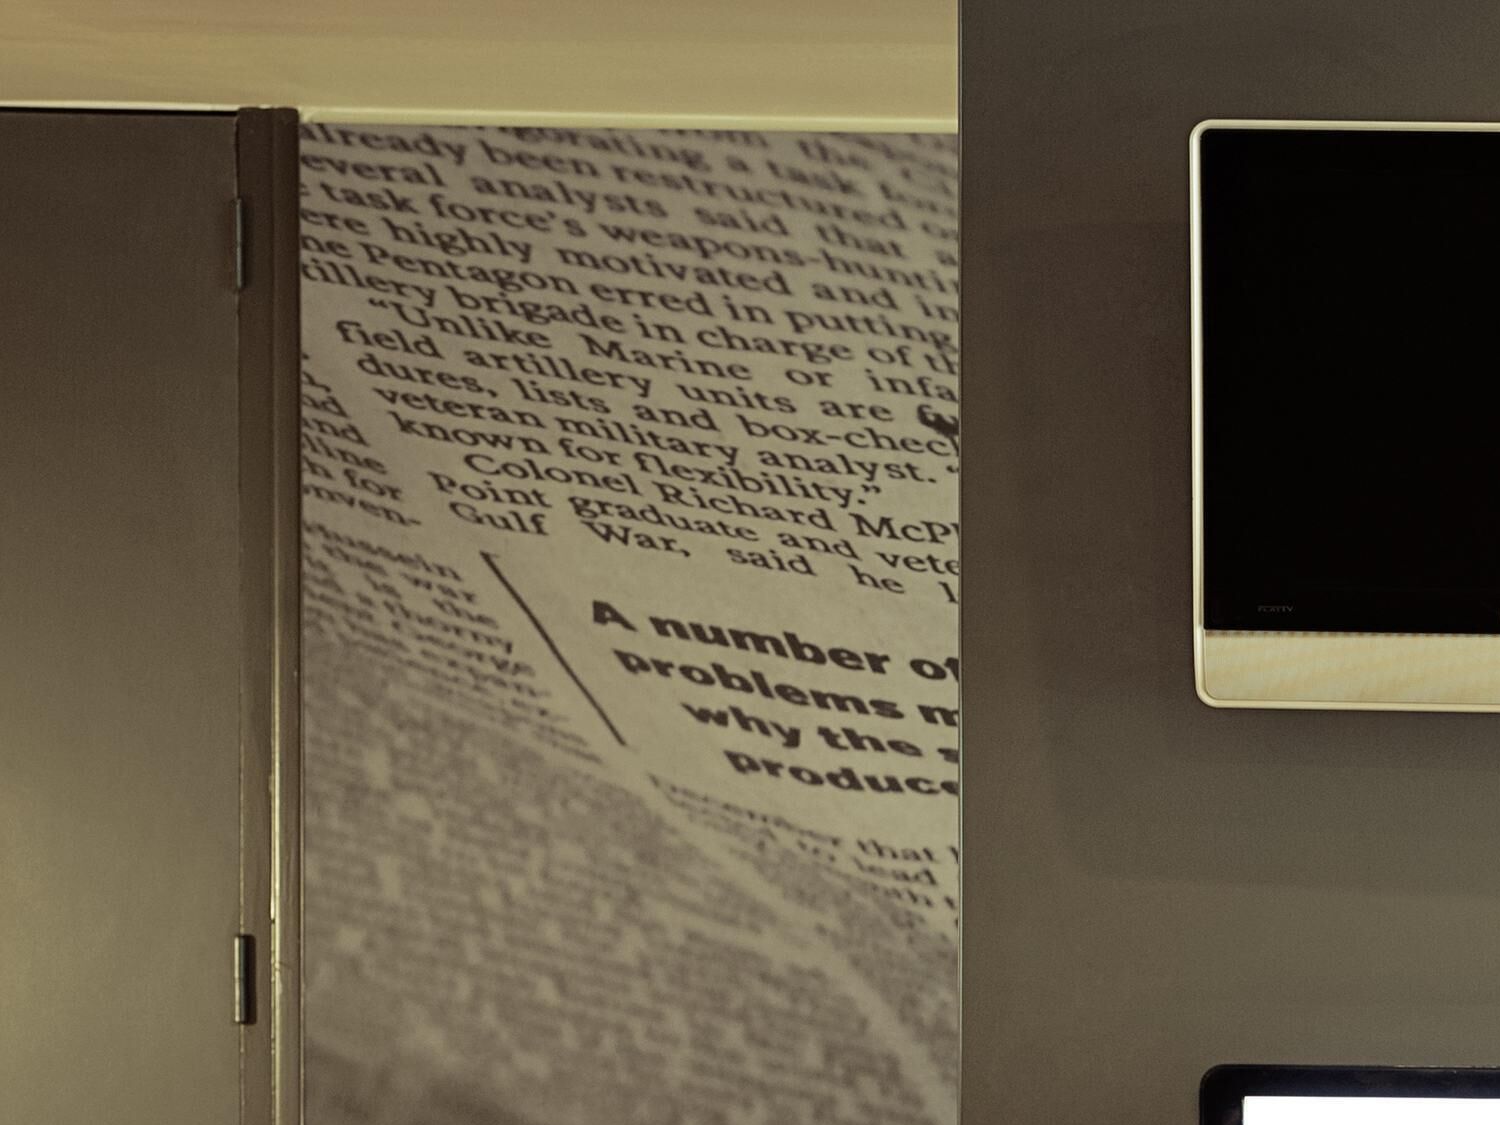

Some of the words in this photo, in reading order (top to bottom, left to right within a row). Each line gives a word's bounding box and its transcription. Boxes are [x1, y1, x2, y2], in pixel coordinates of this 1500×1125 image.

[320, 181, 421, 215] task
[428, 192, 588, 239] force's
[469, 175, 669, 219] analysts
[694, 206, 790, 237] said
[478, 138, 601, 178] been
[612, 163, 908, 232] restructured
[357, 240, 580, 295] Pentagon
[590, 282, 714, 318] erred
[721, 294, 774, 326] in
[783, 309, 957, 354] putting
[380, 215, 533, 265] highly
[556, 248, 794, 297] motivated
[811, 281, 900, 311] and
[445, 284, 626, 335] brigade
[633, 313, 686, 346] in
[697, 325, 855, 366] charge
[867, 345, 915, 368] of
[580, 333, 753, 382] Marine
[785, 368, 834, 388] or
[335, 319, 446, 360] field
[463, 349, 653, 400] artillery
[676, 382, 798, 415] units
[818, 400, 895, 422] are
[356, 352, 499, 399] dures,
[510, 377, 612, 416] lists
[631, 403, 721, 433] and
[372, 386, 548, 430] veteran
[555, 416, 739, 467] military
[756, 449, 937, 484] analyst.
[387, 410, 552, 456] known
[557, 437, 623, 466] for
[343, 467, 403, 503] for
[427, 470, 553, 509] Point
[567, 496, 761, 543] graduate
[776, 531, 863, 561] and
[463, 453, 643, 496] Colonel
[651, 480, 839, 532] Richard
[449, 501, 550, 537] Gulf
[580, 520, 692, 558] War,
[725, 547, 818, 577] said
[848, 563, 906, 595] he
[591, 599, 639, 633] A
[648, 615, 892, 676] number
[611, 647, 906, 720] problems
[680, 701, 802, 749] why
[816, 725, 925, 758] the
